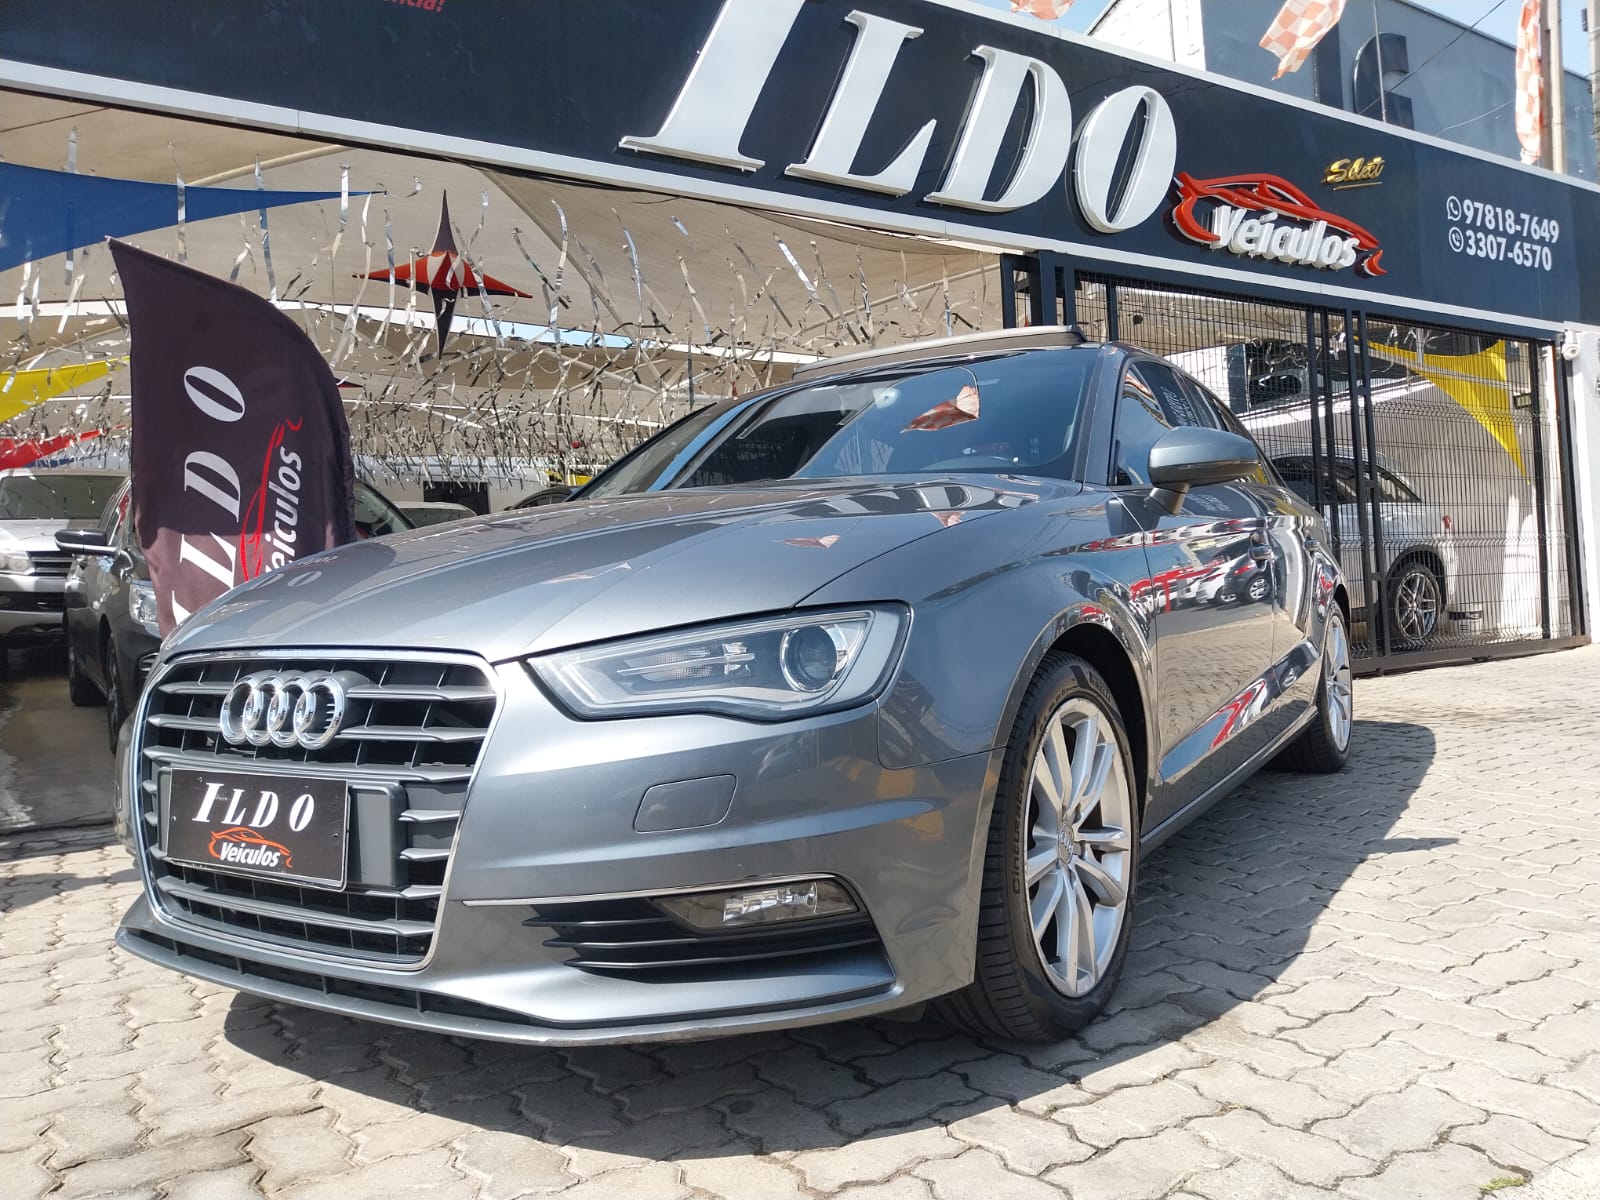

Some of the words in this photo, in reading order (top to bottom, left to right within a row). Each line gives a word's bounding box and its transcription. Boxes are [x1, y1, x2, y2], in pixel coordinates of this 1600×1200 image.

[618, 0, 1177, 234] ILDO
[1210, 204, 1361, 271] Veículos
[1462, 199, 1560, 244] 97818-7649
[1465, 230, 1553, 272] 3307-6570
[171, 366, 245, 626] LDO
[265, 446, 302, 574] eiculos
[191, 782, 315, 832] ILDO
[219, 841, 282, 868] Veiculos
